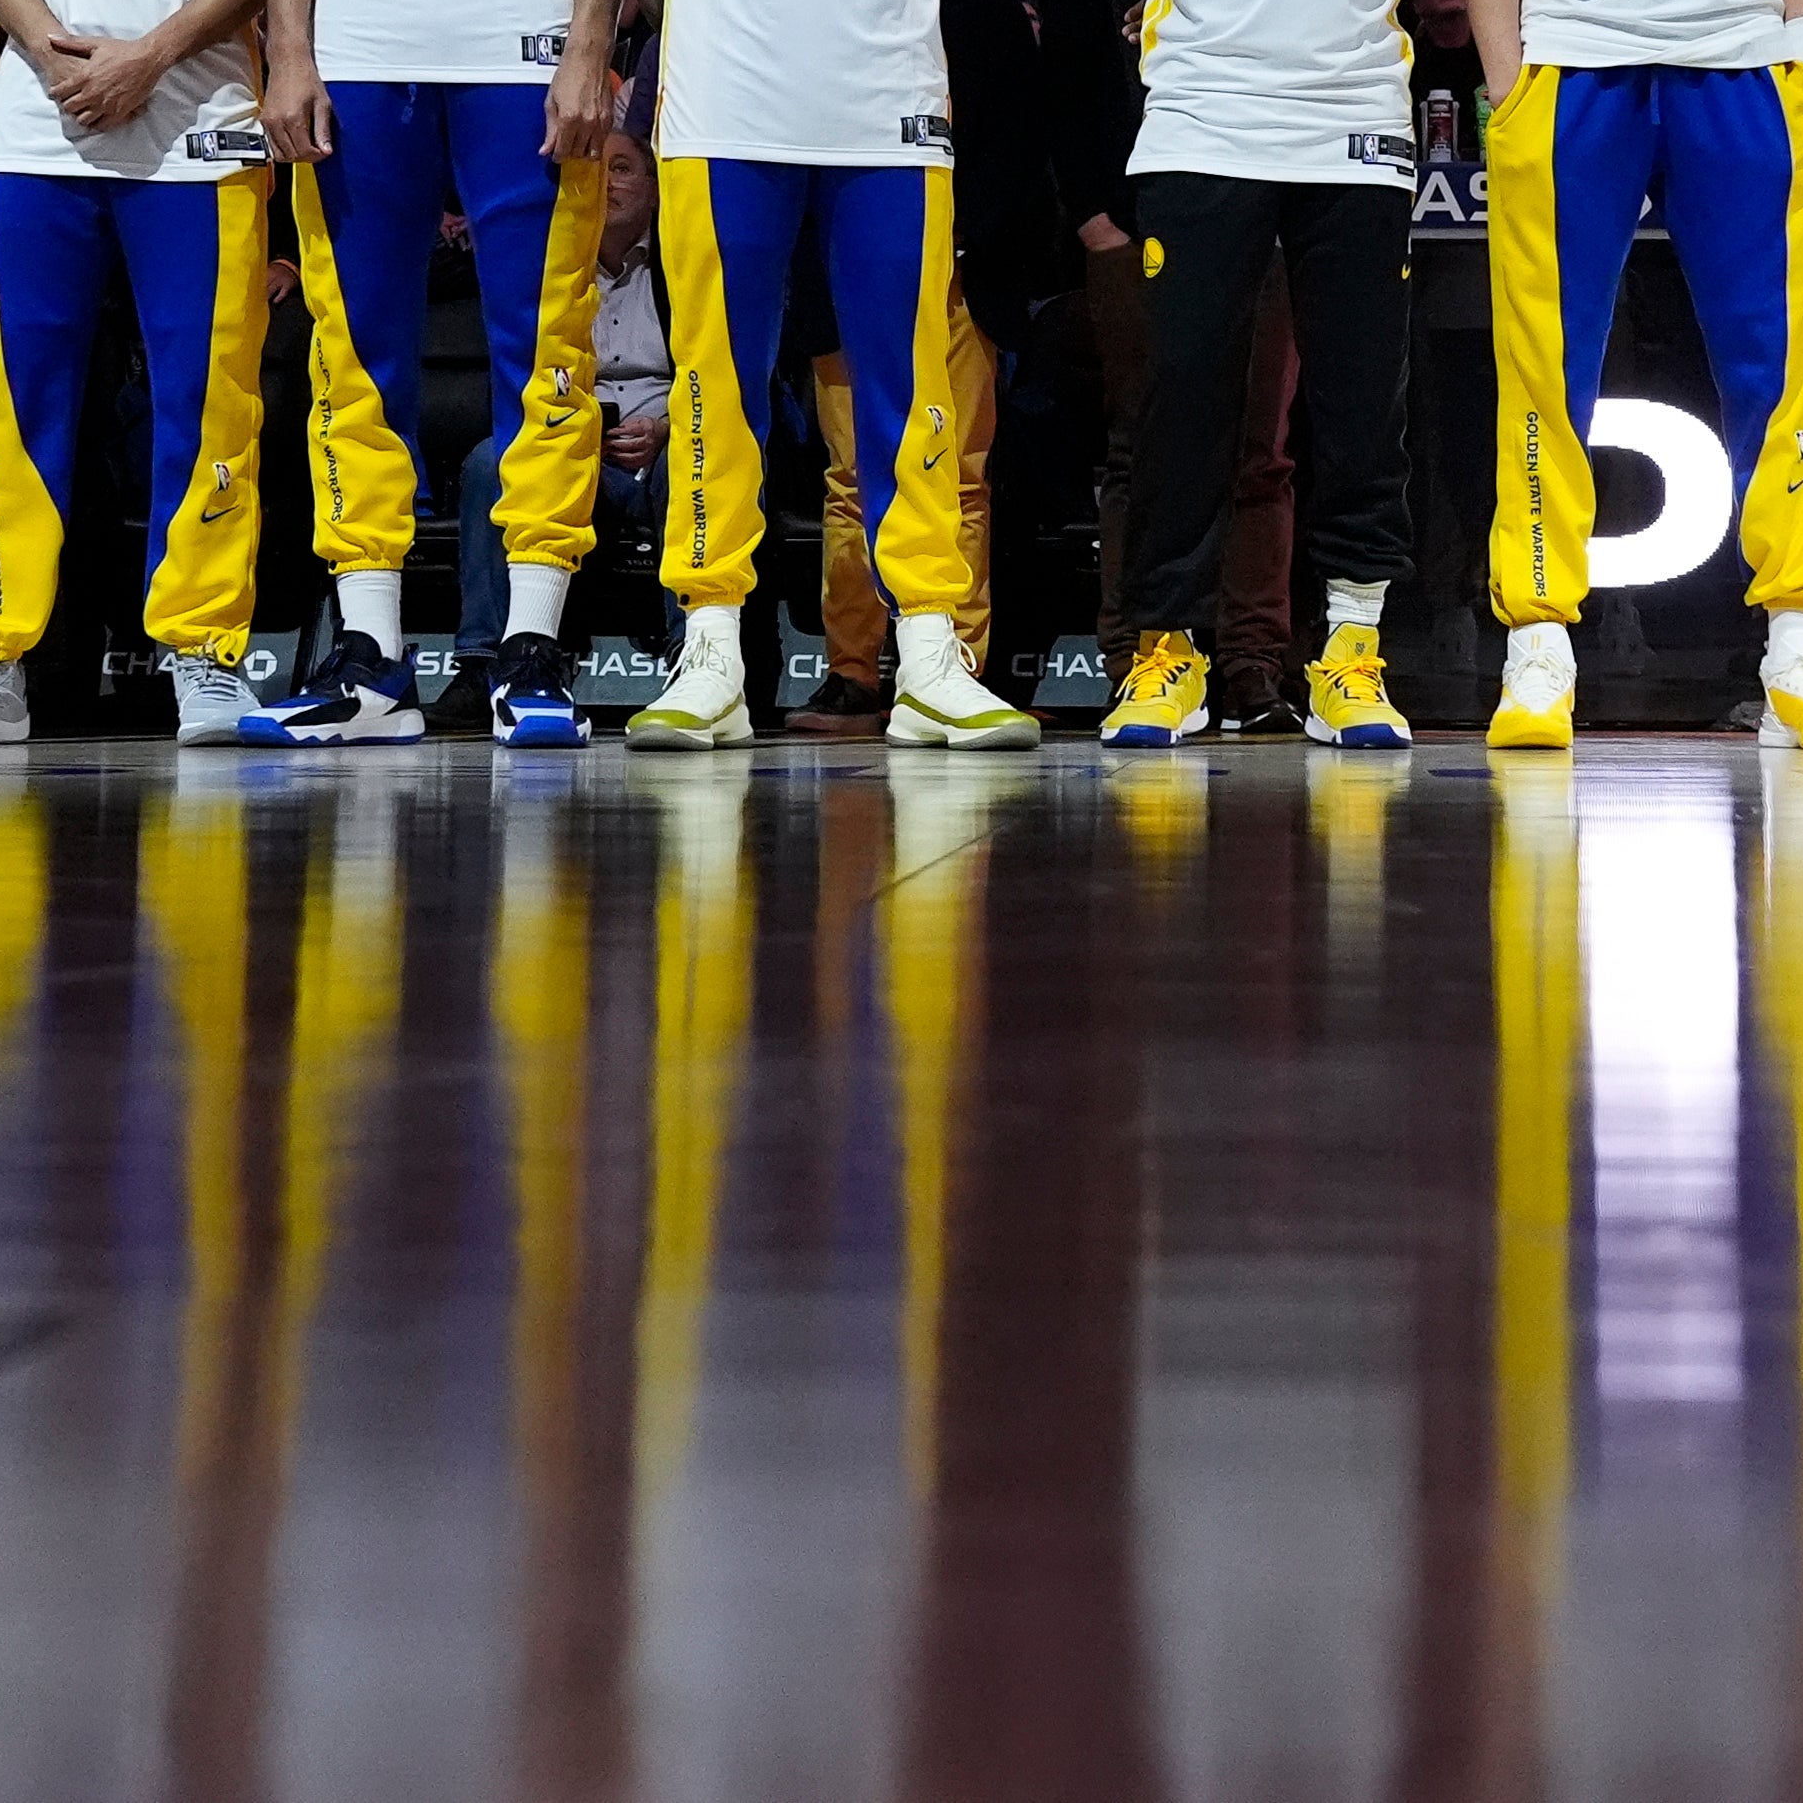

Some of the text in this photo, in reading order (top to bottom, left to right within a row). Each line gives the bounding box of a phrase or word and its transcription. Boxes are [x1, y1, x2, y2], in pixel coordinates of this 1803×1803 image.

[319, 399, 332, 439] STATE
[324, 445, 343, 522] WARRIORS
[689, 370, 705, 569] GOLDEN STATE WARRIORS
[1526, 411, 1546, 597] GOLDEN STATE WARRIORS
[102, 652, 178, 675] CHA
[568, 652, 670, 676] HASE
[1011, 653, 1108, 677] CHAS
